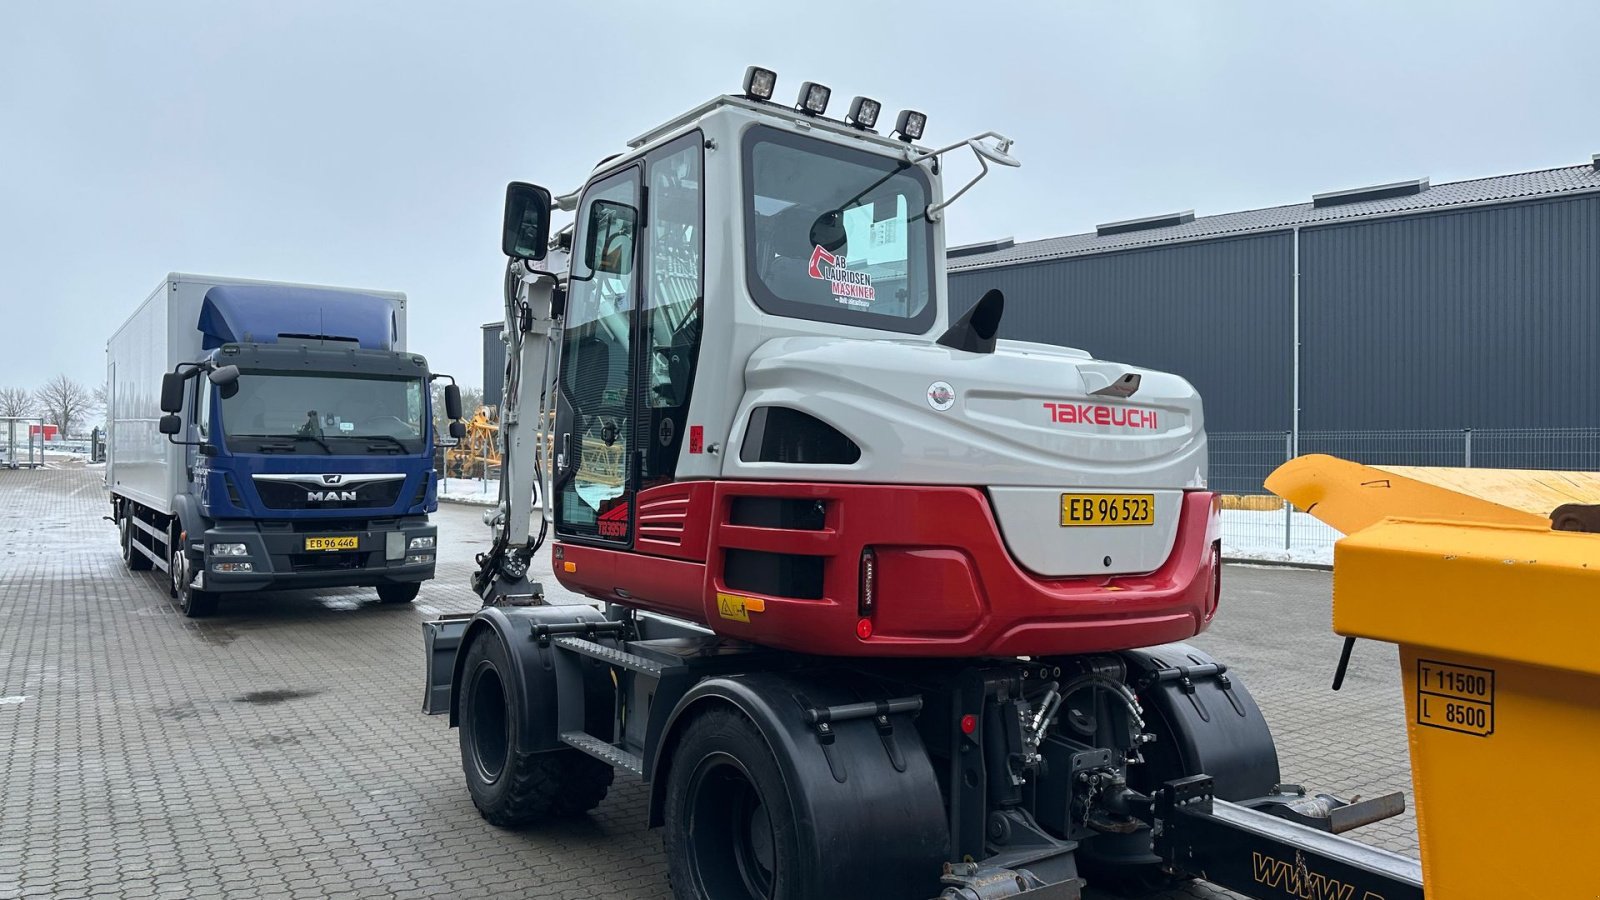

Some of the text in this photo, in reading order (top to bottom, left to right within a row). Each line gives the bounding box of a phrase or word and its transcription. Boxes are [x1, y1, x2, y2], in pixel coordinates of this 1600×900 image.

[835, 255, 846, 269] AB
[825, 267, 871, 286] LAURIDSEN
[832, 282, 875, 299] MASKINER
[307, 491, 357, 501] MAN
[1070, 498, 1148, 521] EB 96 523
[310, 538, 354, 548] EB 96 446
[1422, 667, 1486, 696] T 11500
[1423, 698, 1486, 728] L 8500
